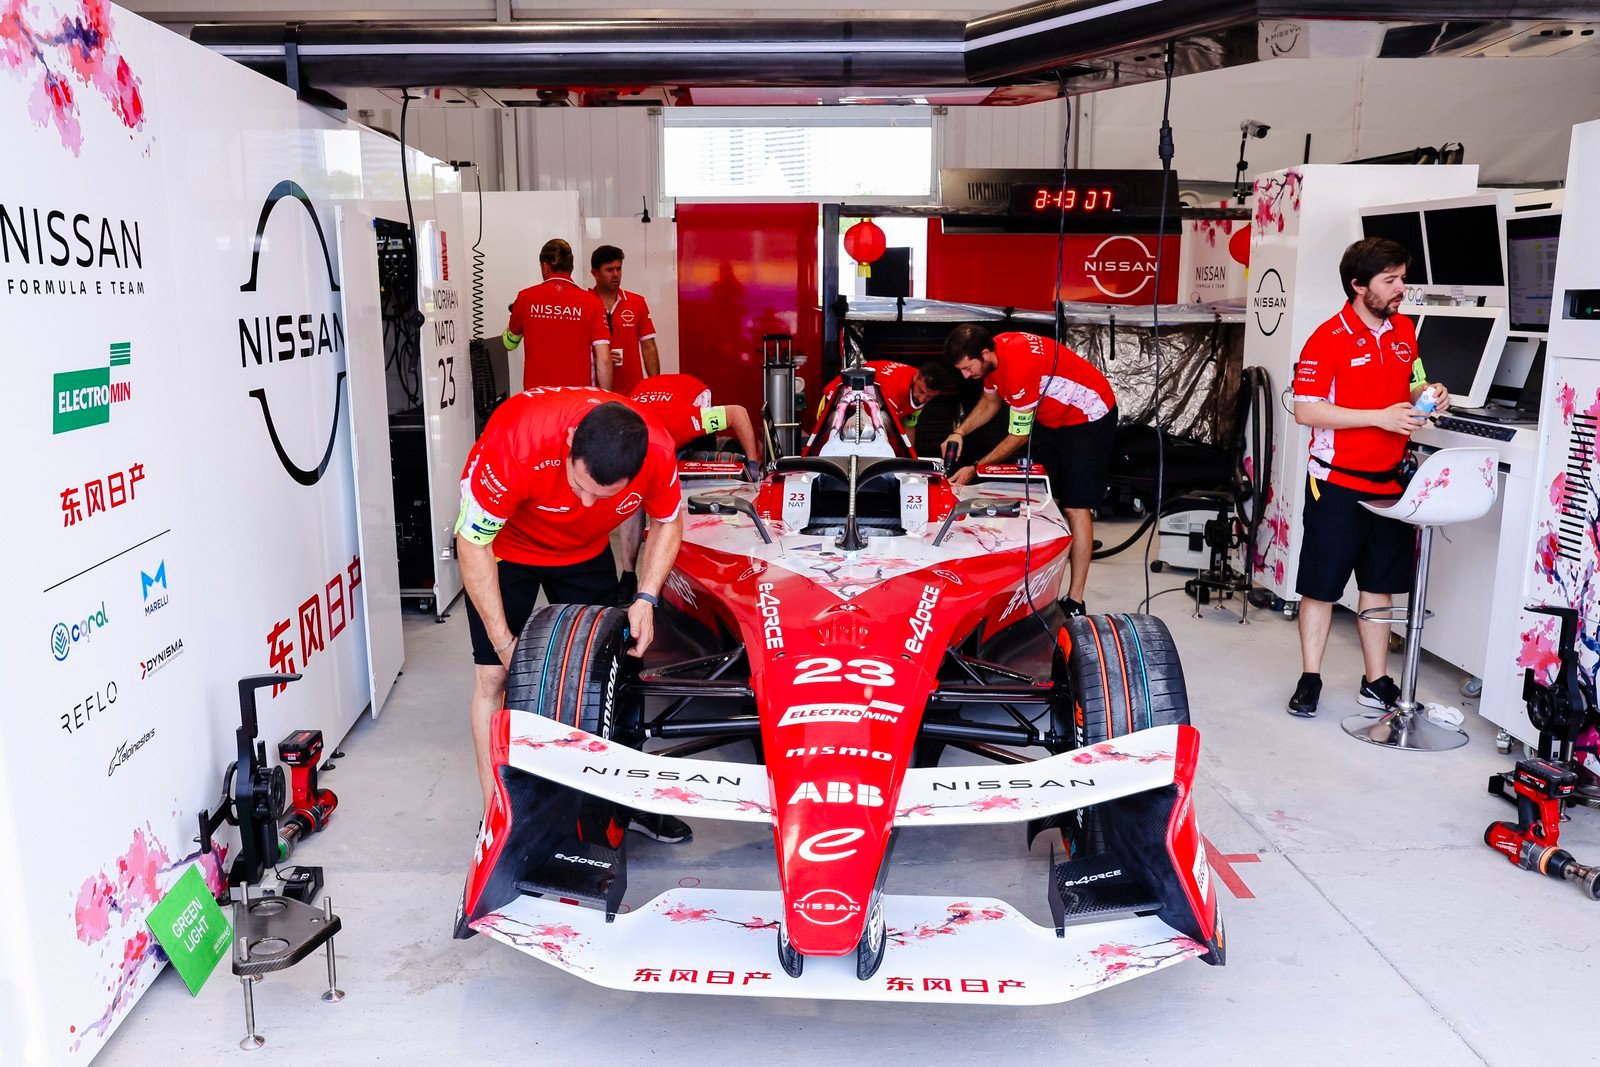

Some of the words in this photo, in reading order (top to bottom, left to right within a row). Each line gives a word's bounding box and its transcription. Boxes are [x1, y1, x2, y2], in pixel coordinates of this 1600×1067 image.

[0, 204, 142, 269] NISSAN
[1084, 261, 1158, 272] NISSAN
[1195, 266, 1226, 281] NISSAN
[8, 279, 87, 295] FORMULA
[96, 281, 102, 295] E
[111, 281, 145, 295] TEAM
[433, 290, 459, 309] NORMAN
[531, 304, 582, 317] NISSAN
[1254, 297, 1287, 308] NISSAN
[238, 312, 345, 368] NISSAN
[435, 319, 455, 347] NATO
[438, 356, 456, 409] 23
[58, 381, 131, 414] ELECTROMIN
[60, 463, 146, 528] 东风日产
[790, 493, 805, 501] 23
[907, 495, 922, 503] 23
[144, 594, 169, 617] MARELLI
[267, 554, 362, 699] 东风日产
[146, 638, 184, 672] DYNISMA
[793, 658, 896, 687] 23
[60, 681, 118, 734] REFLO
[789, 708, 899, 724] ELECTROMIN
[121, 728, 156, 763] alpinestars
[785, 746, 893, 762] nismo
[582, 765, 742, 786] NISSAN
[933, 779, 1096, 791] NISSAN
[787, 781, 885, 807] ABB
[172, 896, 204, 938] GREEN
[793, 902, 861, 912] NISSAN
[184, 915, 210, 953] LIGHT
[632, 967, 772, 985] 东风日产
[887, 976, 1027, 994] 东风日产
